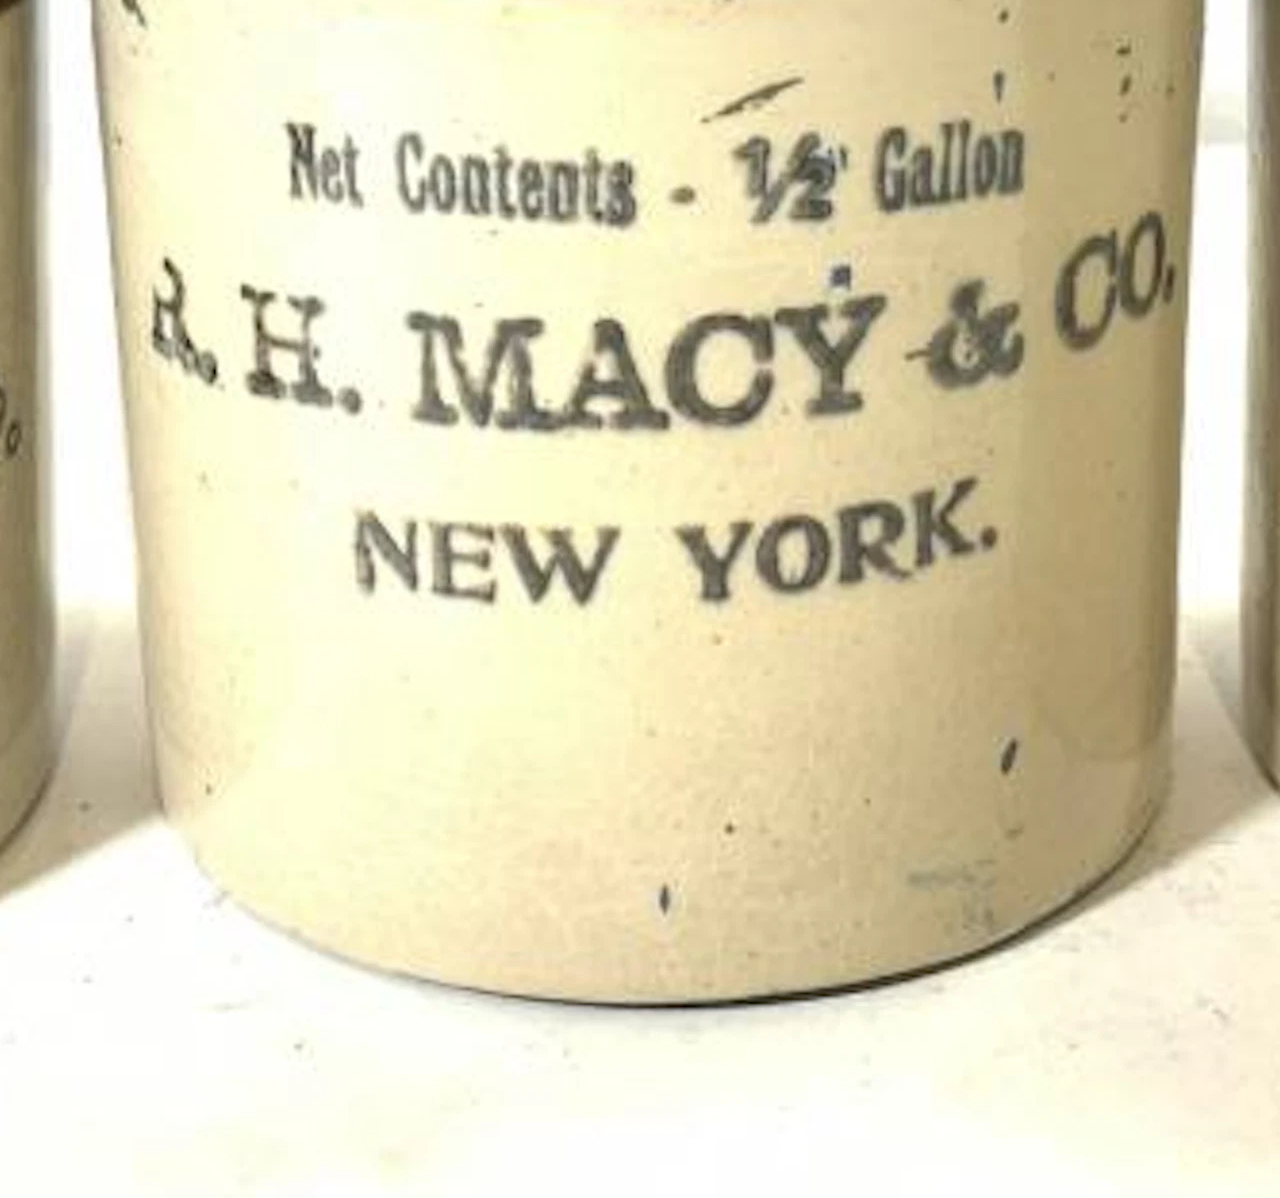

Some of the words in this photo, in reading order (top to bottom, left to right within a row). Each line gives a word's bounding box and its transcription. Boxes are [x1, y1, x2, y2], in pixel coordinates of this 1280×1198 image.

[285, 122, 360, 207] Net
[395, 133, 637, 226] Contents
[875, 119, 1024, 212] Gallon
[152, 257, 218, 386] R.
[240, 284, 363, 416] H.
[406, 292, 886, 432] MACY
[925, 280, 1024, 390] &
[1053, 212, 1177, 350] CO.
[351, 507, 620, 604] NEW
[676, 477, 999, 603] YORK.
